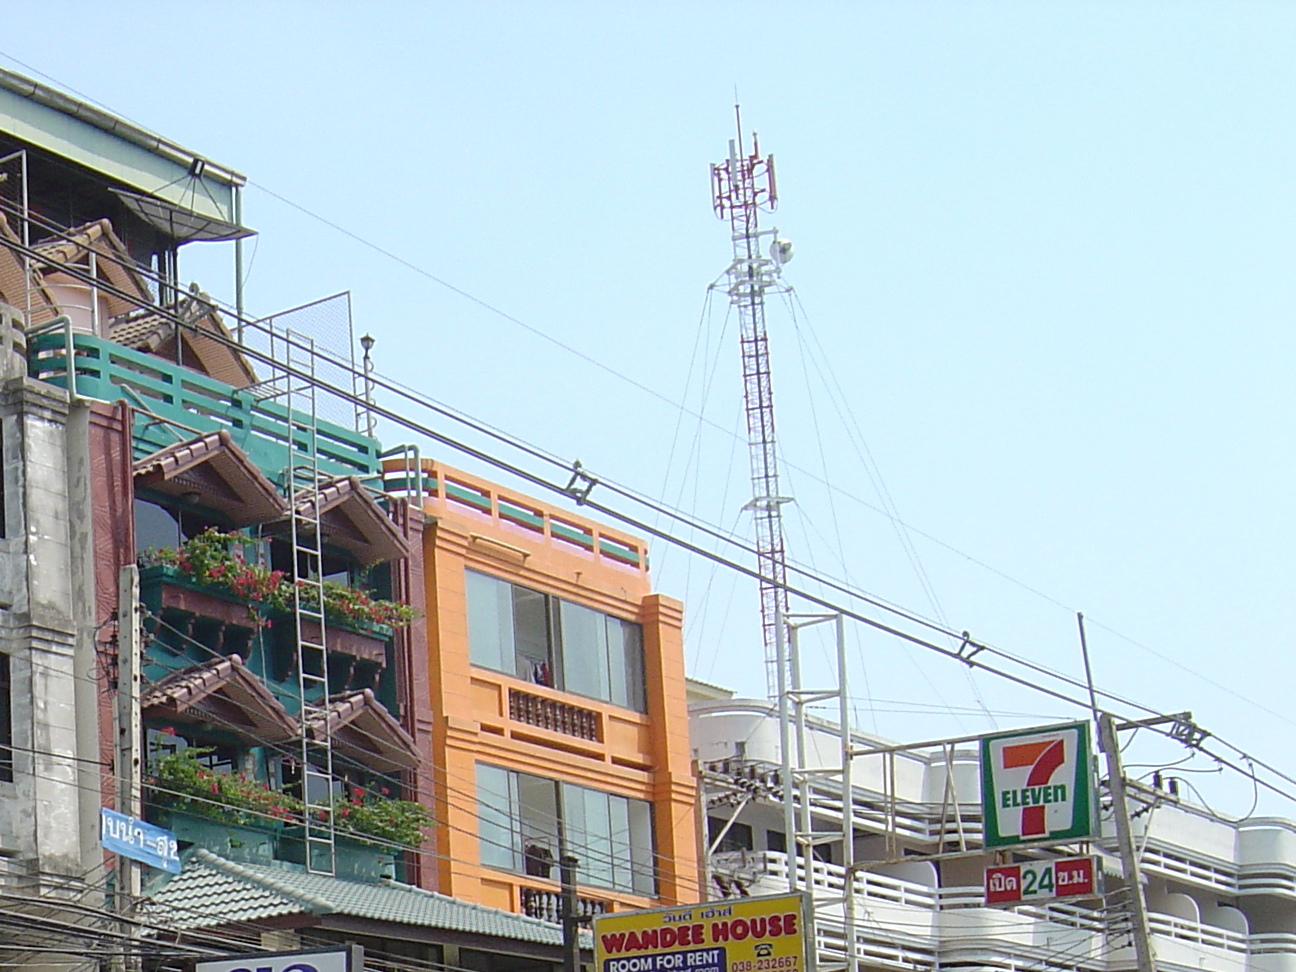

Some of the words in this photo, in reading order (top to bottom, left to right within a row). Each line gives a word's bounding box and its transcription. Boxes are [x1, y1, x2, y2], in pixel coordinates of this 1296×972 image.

[989, 872, 1017, 892] เปิด
[1022, 866, 1055, 896] 24
[601, 923, 705, 955] WANDEE
[711, 913, 798, 943] HOUSE
[656, 954, 682, 969] FOR
[687, 950, 719, 966] RENT
[731, 956, 798, 972] 038-232667
